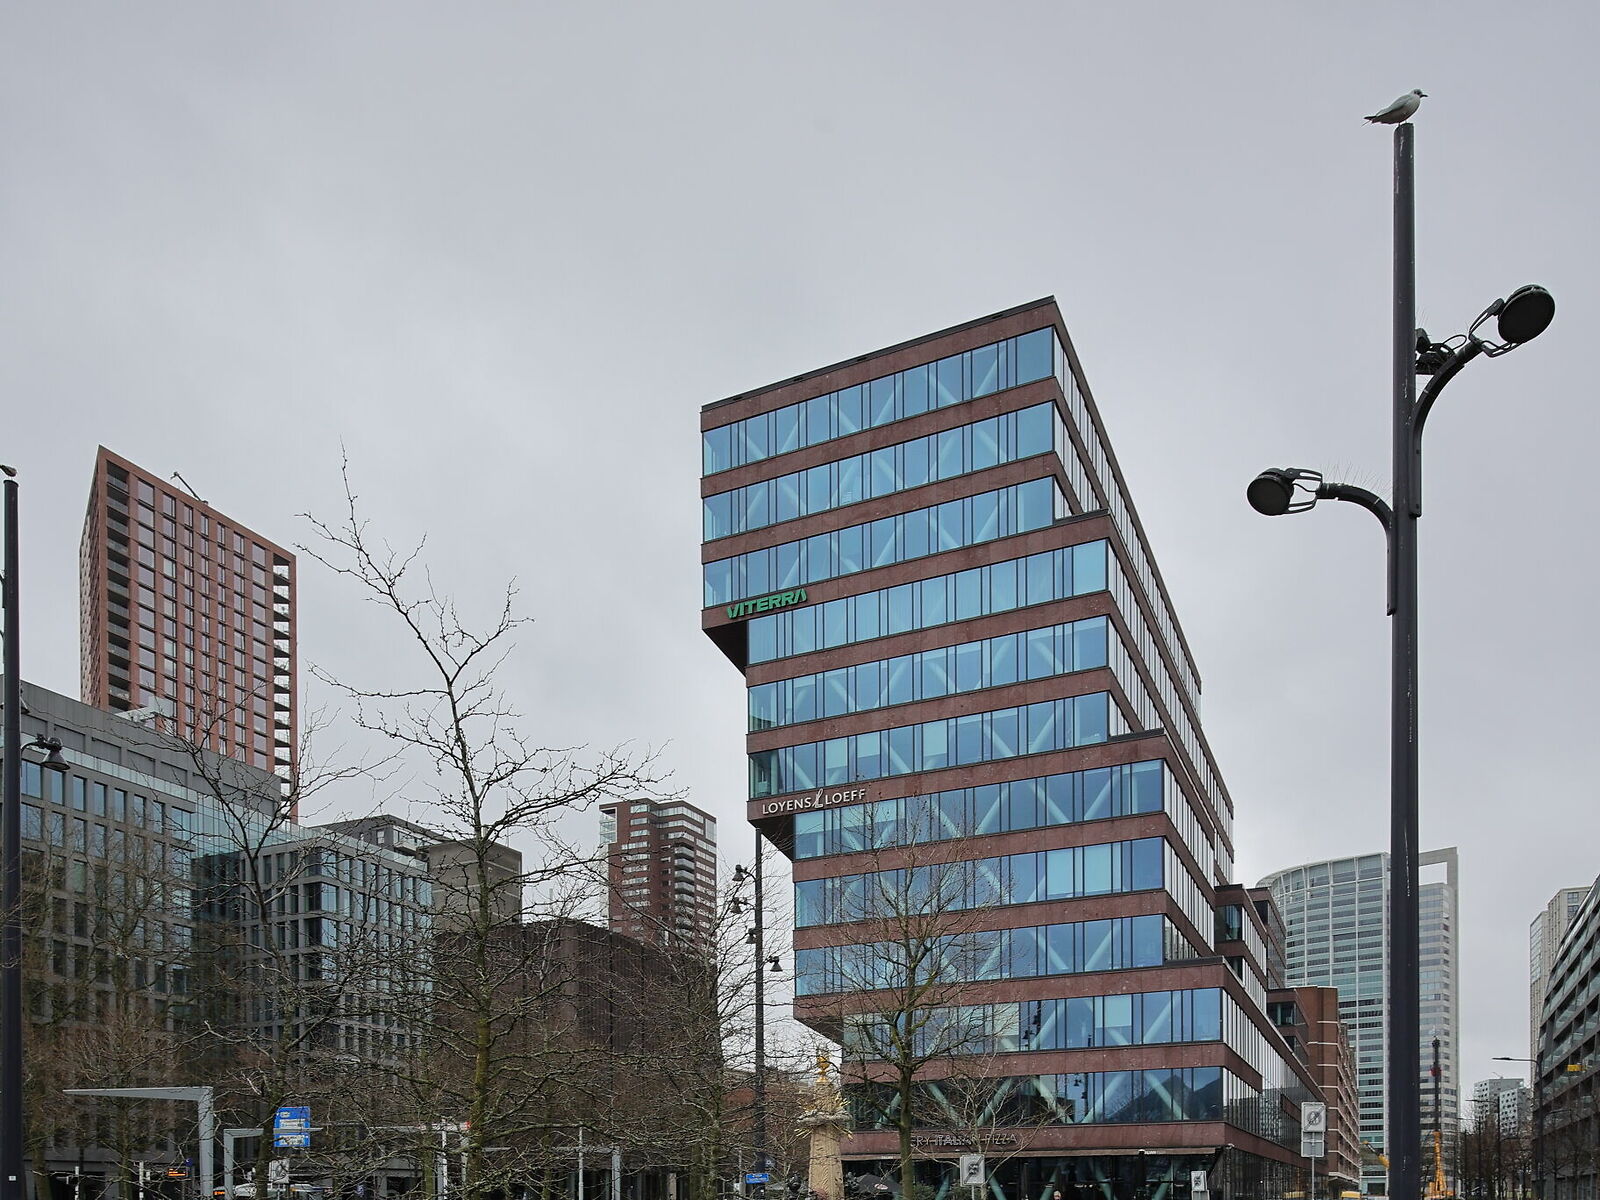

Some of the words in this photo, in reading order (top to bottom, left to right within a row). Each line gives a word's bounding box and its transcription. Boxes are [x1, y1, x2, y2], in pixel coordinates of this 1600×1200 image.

[726, 588, 807, 619] VITERRA
[762, 797, 812, 815] LOYENS
[825, 788, 866, 805] LOEFF
